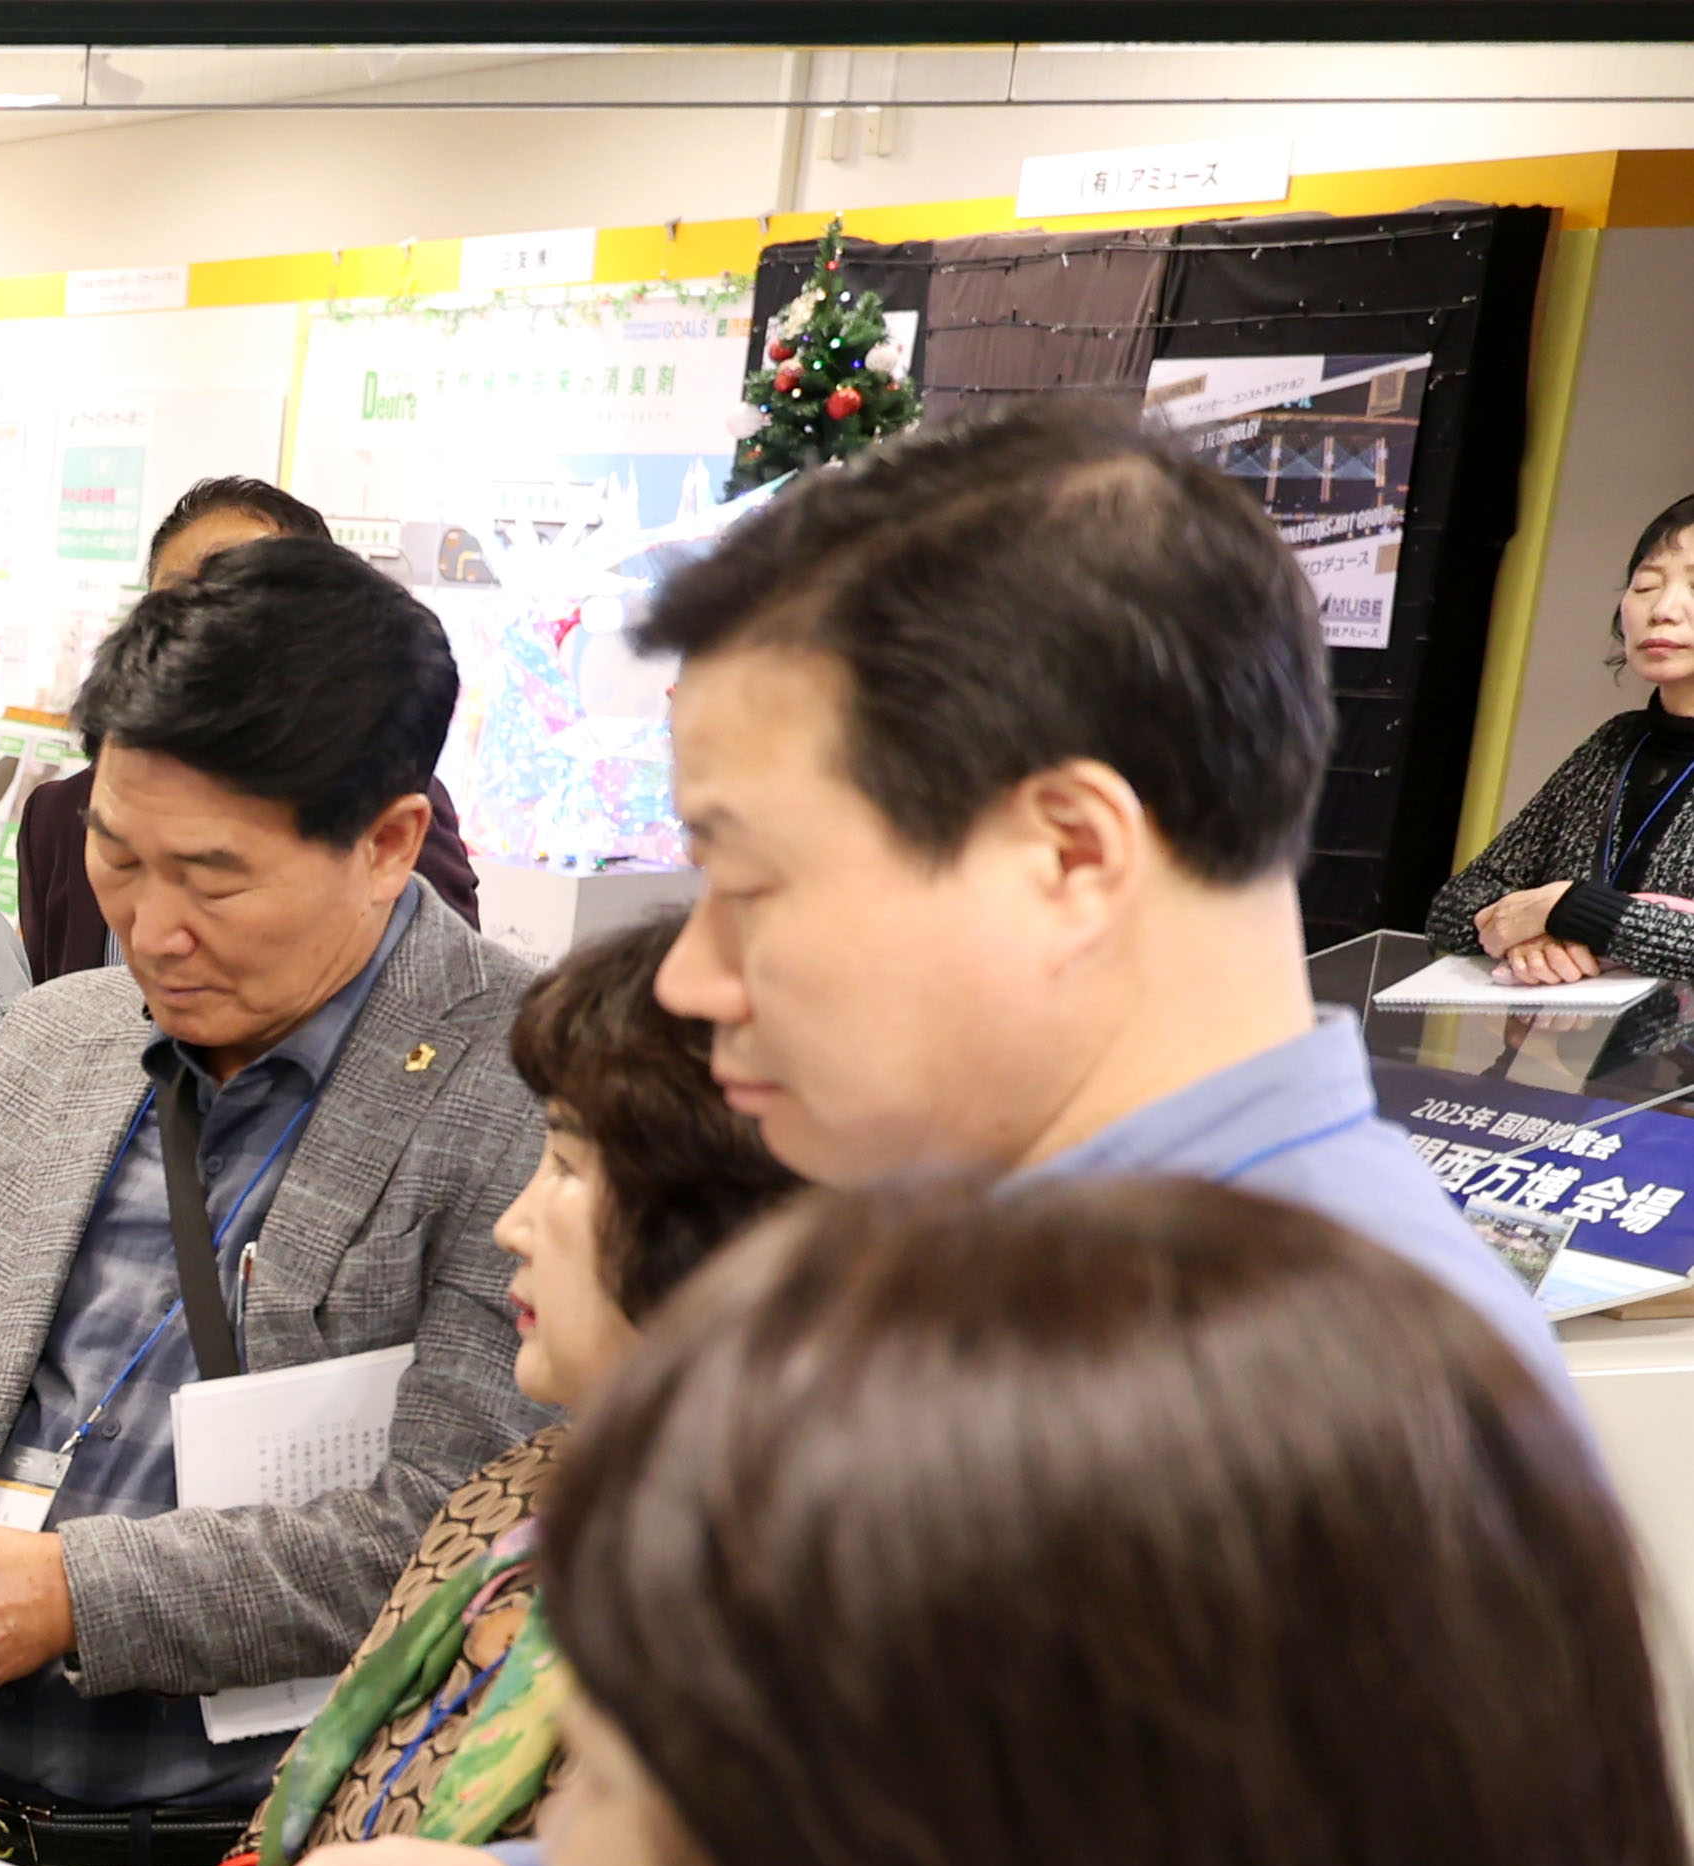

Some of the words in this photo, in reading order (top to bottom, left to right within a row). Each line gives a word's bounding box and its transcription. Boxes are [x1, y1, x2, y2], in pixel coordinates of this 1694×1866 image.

[1411, 1096, 1499, 1132] 2025年
[1488, 1111, 1623, 1162] 国際博覧会
[1561, 1175, 1686, 1235] 会場
